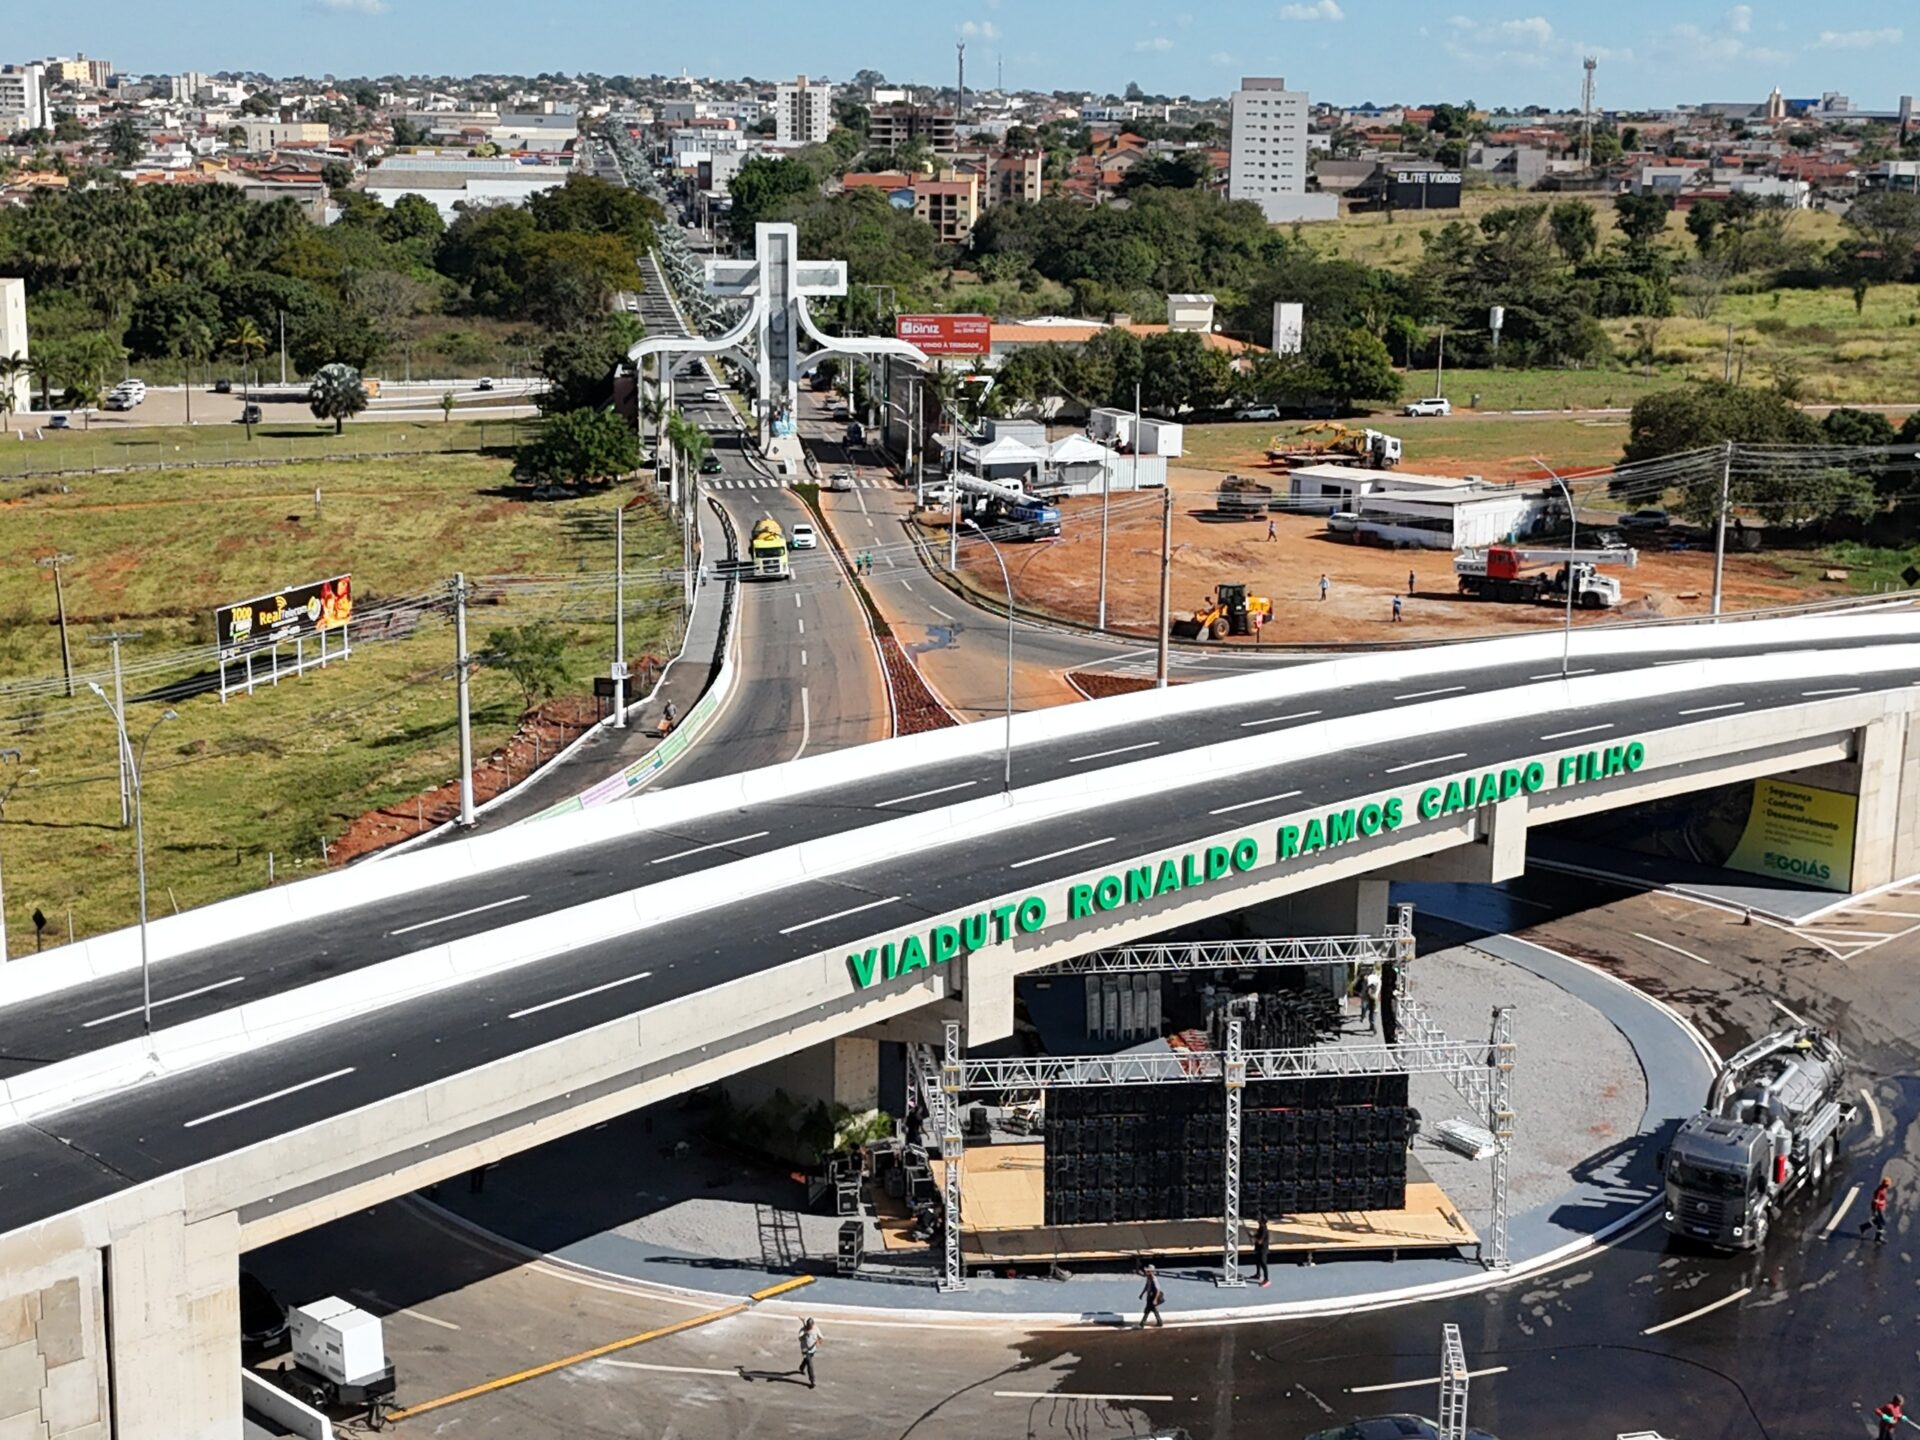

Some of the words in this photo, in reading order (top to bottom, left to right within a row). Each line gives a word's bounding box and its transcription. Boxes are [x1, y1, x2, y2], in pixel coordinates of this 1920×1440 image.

[1398, 173, 1427, 183] ELITE
[1429, 173, 1461, 183] VIDROS
[259, 607, 281, 625] Real
[1769, 786, 1812, 802] Segurança
[1768, 798, 1804, 811] Conforto
[1767, 808, 1839, 831] Desenvolvimento
[846, 896, 1047, 988] VIADUTO
[1067, 837, 1259, 920] RONALDO
[1276, 797, 1403, 859] RAMOS
[1416, 762, 1545, 820] CAIADO
[1557, 741, 1645, 786] FILHO
[1777, 855, 1830, 880] GOIÁS
